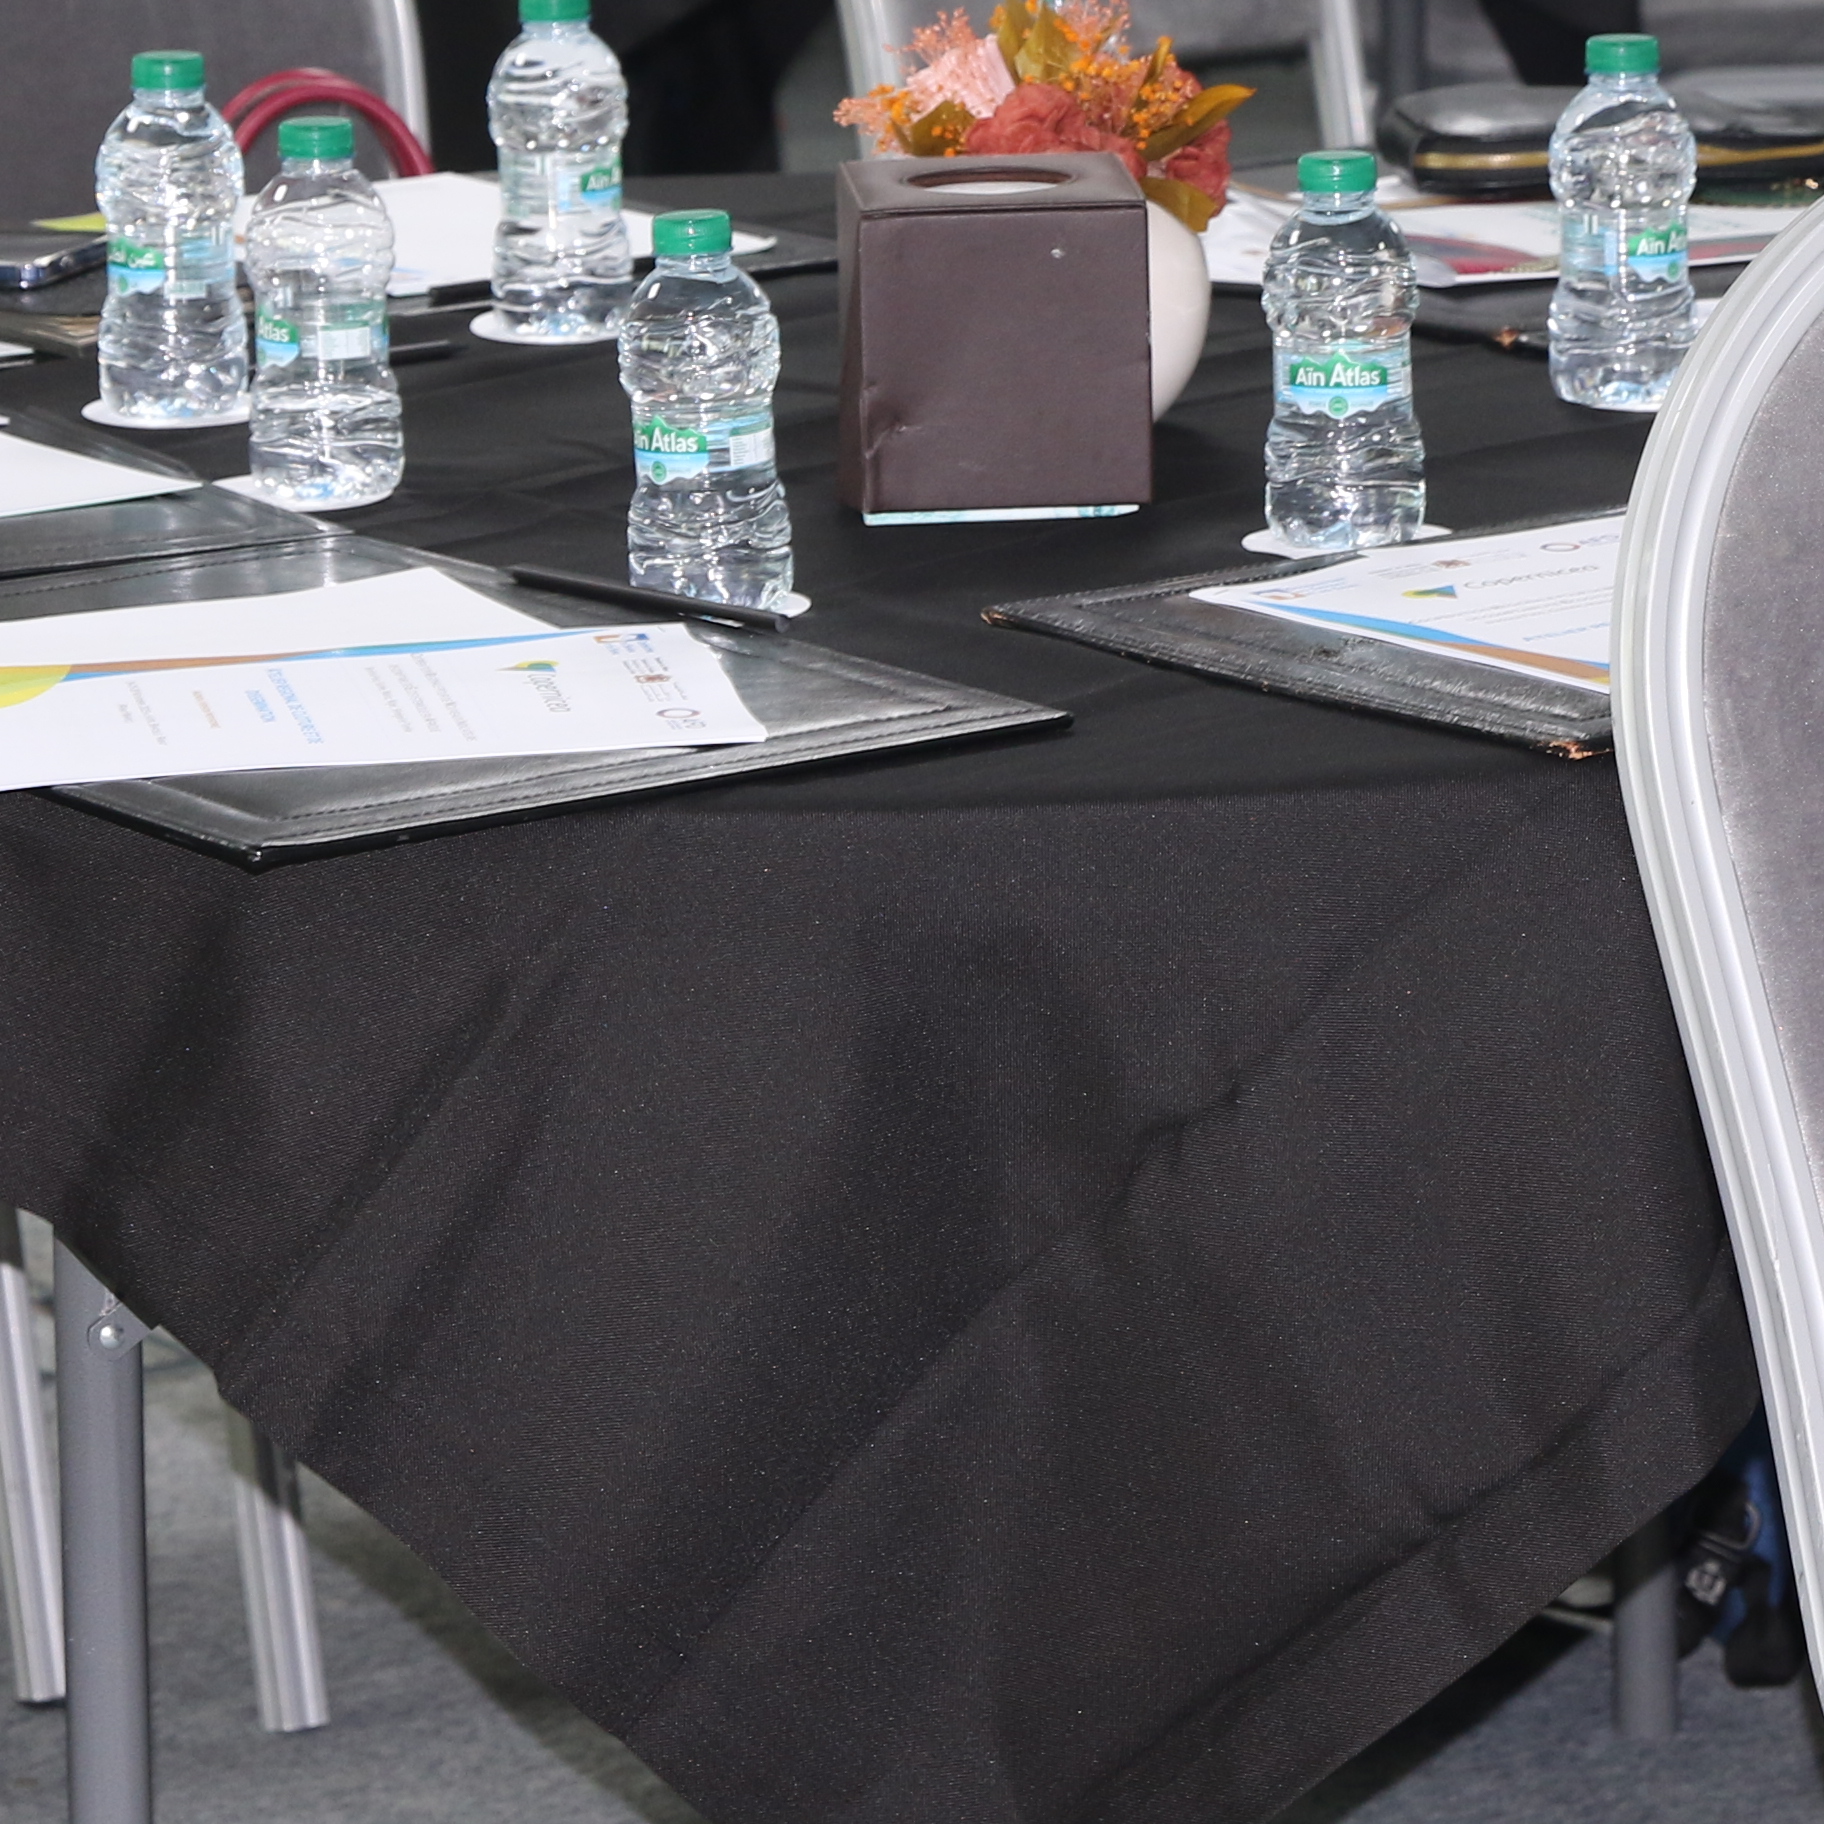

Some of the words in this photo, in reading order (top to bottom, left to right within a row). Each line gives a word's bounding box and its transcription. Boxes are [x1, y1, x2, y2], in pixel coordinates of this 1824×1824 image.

[1295, 366, 1326, 387] Aïn
[1329, 361, 1382, 388] Atlas
[651, 425, 699, 453] Atlas
